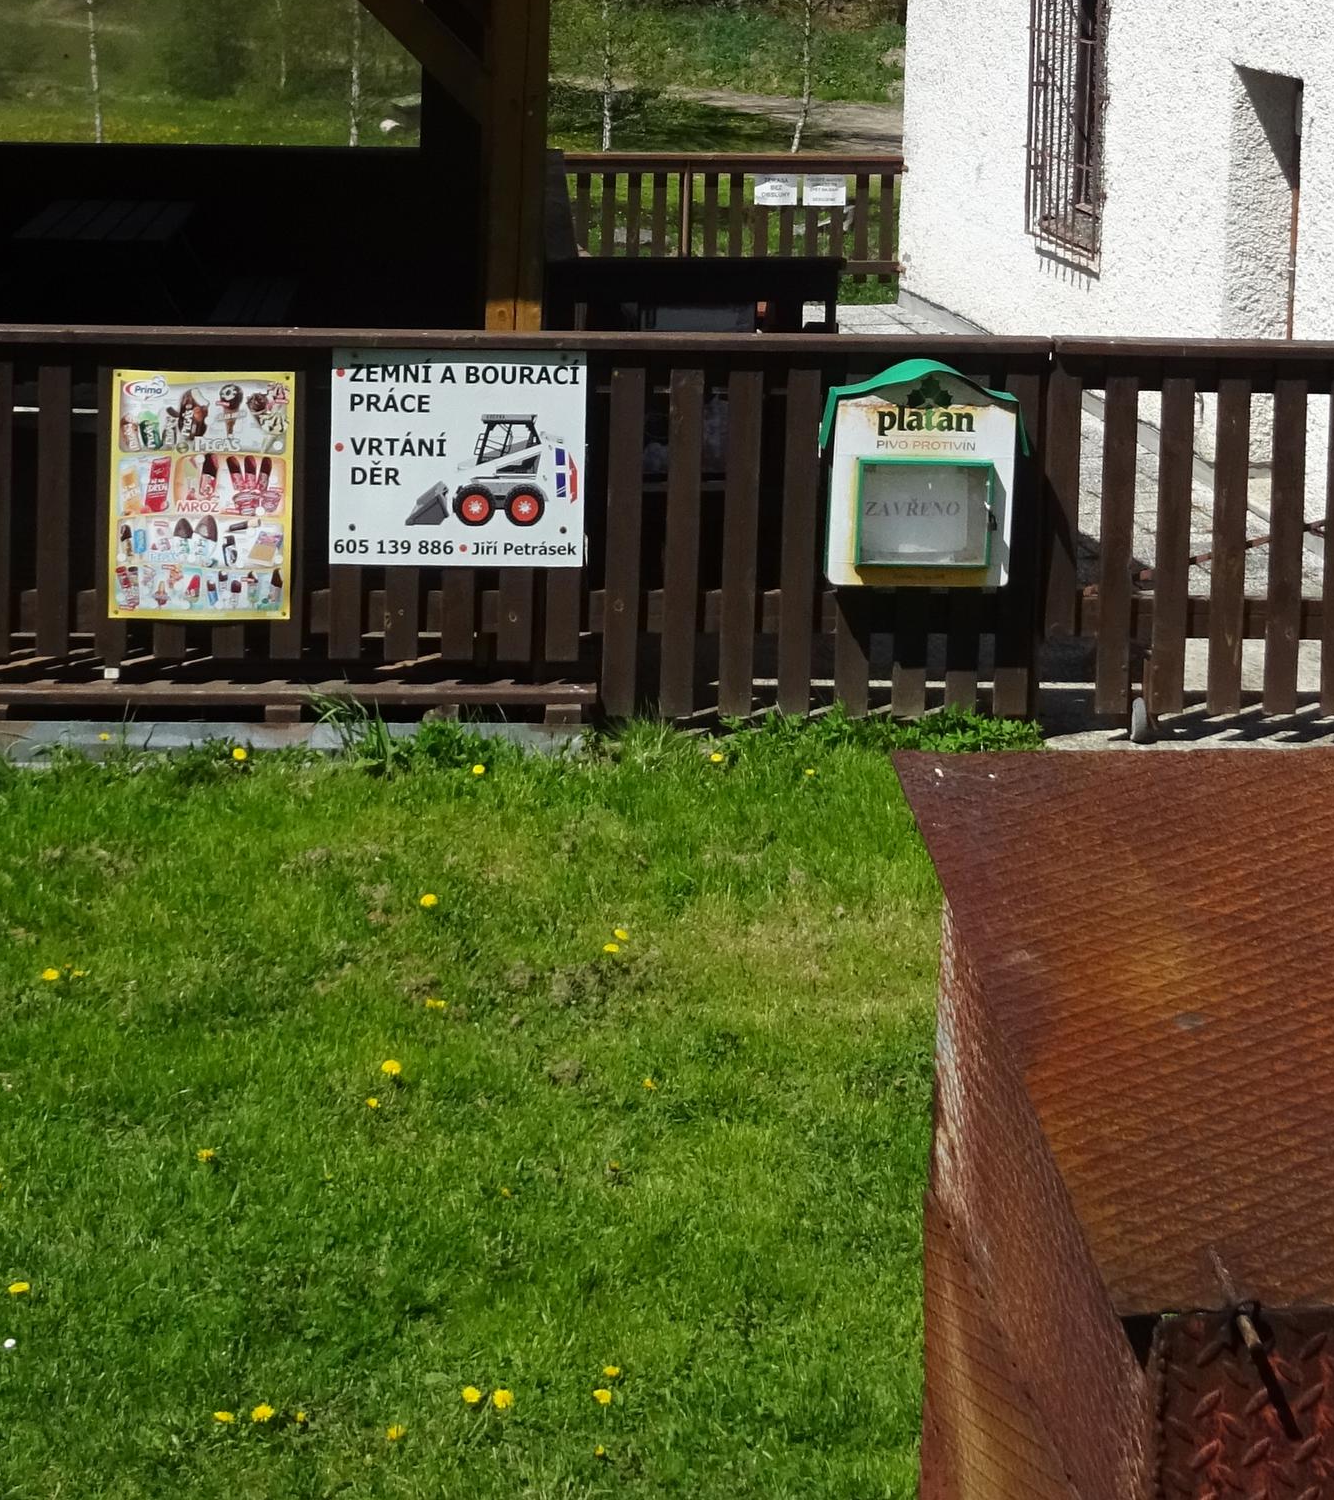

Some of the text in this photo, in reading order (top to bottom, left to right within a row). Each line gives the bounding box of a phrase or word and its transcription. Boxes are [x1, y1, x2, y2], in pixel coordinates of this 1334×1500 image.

[349, 359, 580, 385] ZEMNÍ A BOURACÍ
[349, 388, 431, 413] PRÁCE
[876, 404, 976, 437] platan
[350, 432, 447, 457] VRTÁNÍ
[876, 439, 909, 450] PIVO
[351, 461, 401, 486] DĚR
[333, 540, 577, 556] 605 139 886 Jiří Petrásek
